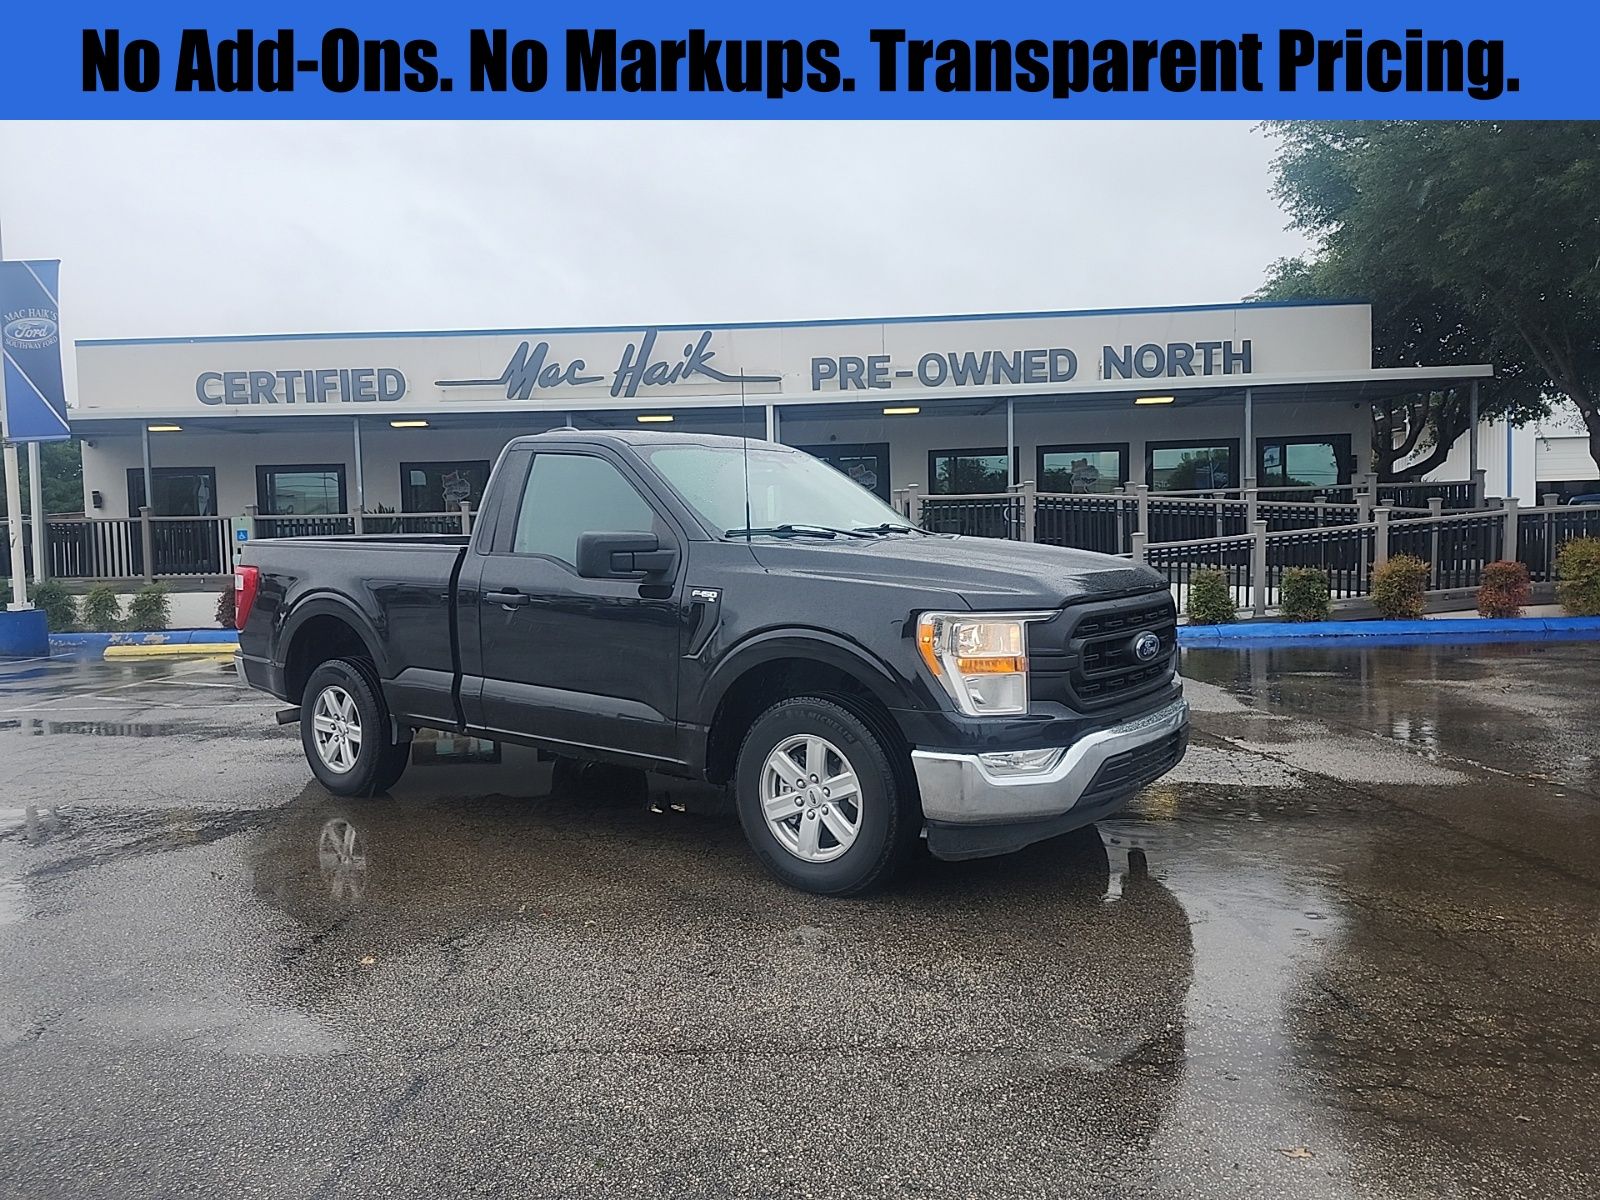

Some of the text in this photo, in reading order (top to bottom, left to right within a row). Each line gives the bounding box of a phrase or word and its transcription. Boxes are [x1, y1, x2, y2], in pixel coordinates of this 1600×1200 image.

[4, 308, 58, 322] MAC HAIK'S
[4, 335, 58, 349] SOUTHWAY FORD
[14, 323, 49, 338] Ford
[434, 327, 783, 400] Mac Haik
[811, 339, 1252, 391] PRE-OWNED NORTH
[196, 368, 406, 406] CERTIFIED
